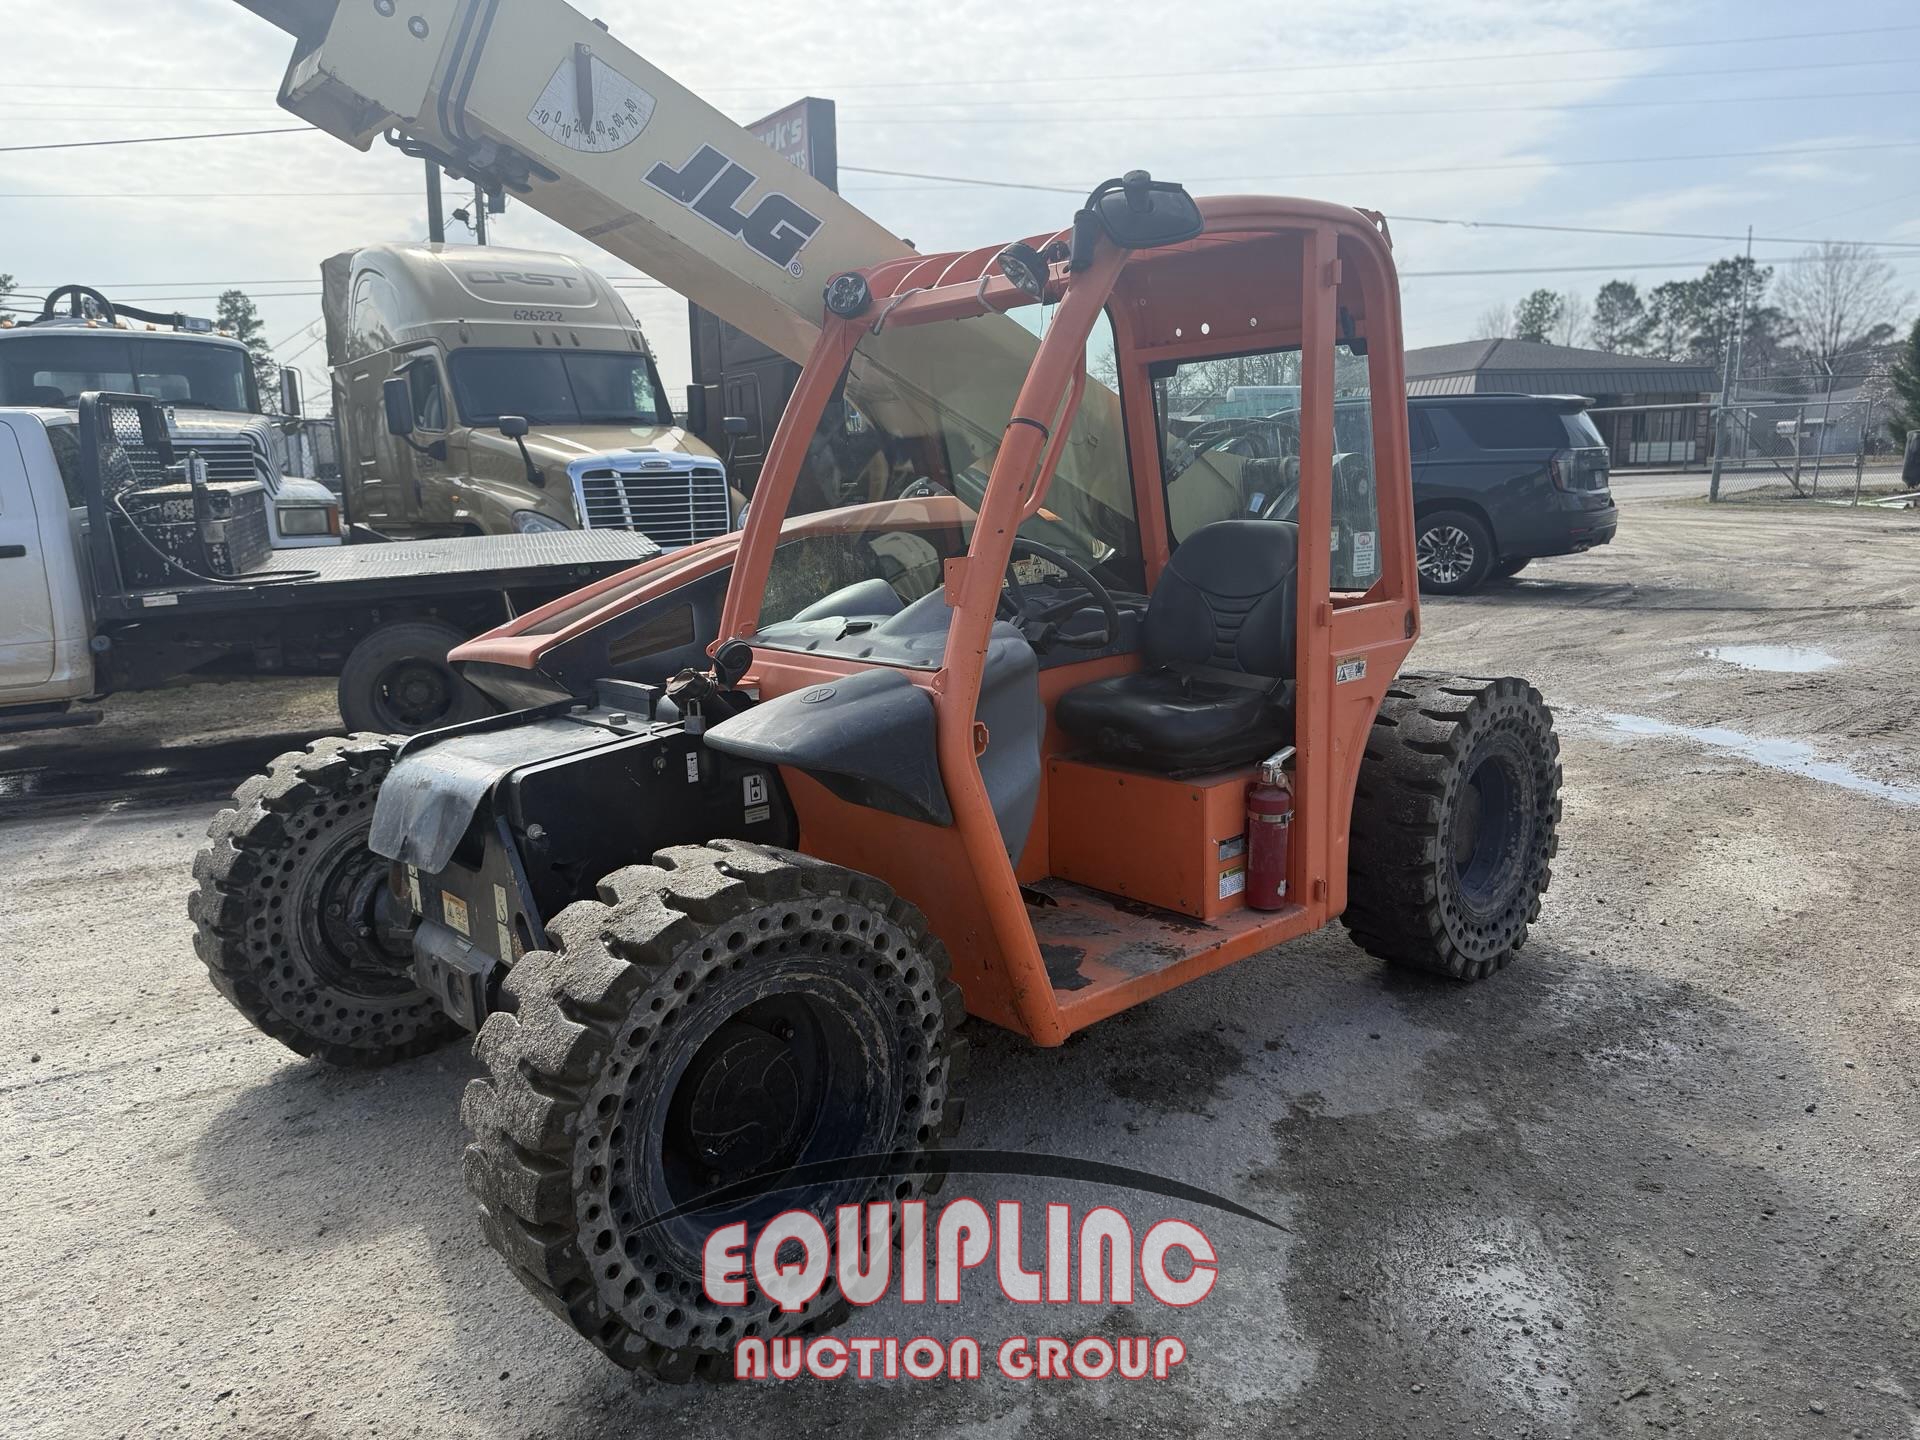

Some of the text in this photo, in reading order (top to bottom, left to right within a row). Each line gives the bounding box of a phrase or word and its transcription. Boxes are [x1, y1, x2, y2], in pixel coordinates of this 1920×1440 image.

[624, 98, 637, 113] 80
[534, 109, 549, 124] -10
[555, 110, 562, 124] 0
[612, 112, 625, 128] 60
[625, 113, 638, 129] 70
[561, 123, 571, 139] 10
[596, 120, 606, 135] 40
[607, 126, 620, 141] 50
[643, 143, 824, 268] JLG
[467, 271, 577, 289] CRST
[514, 310, 564, 322] 626222
